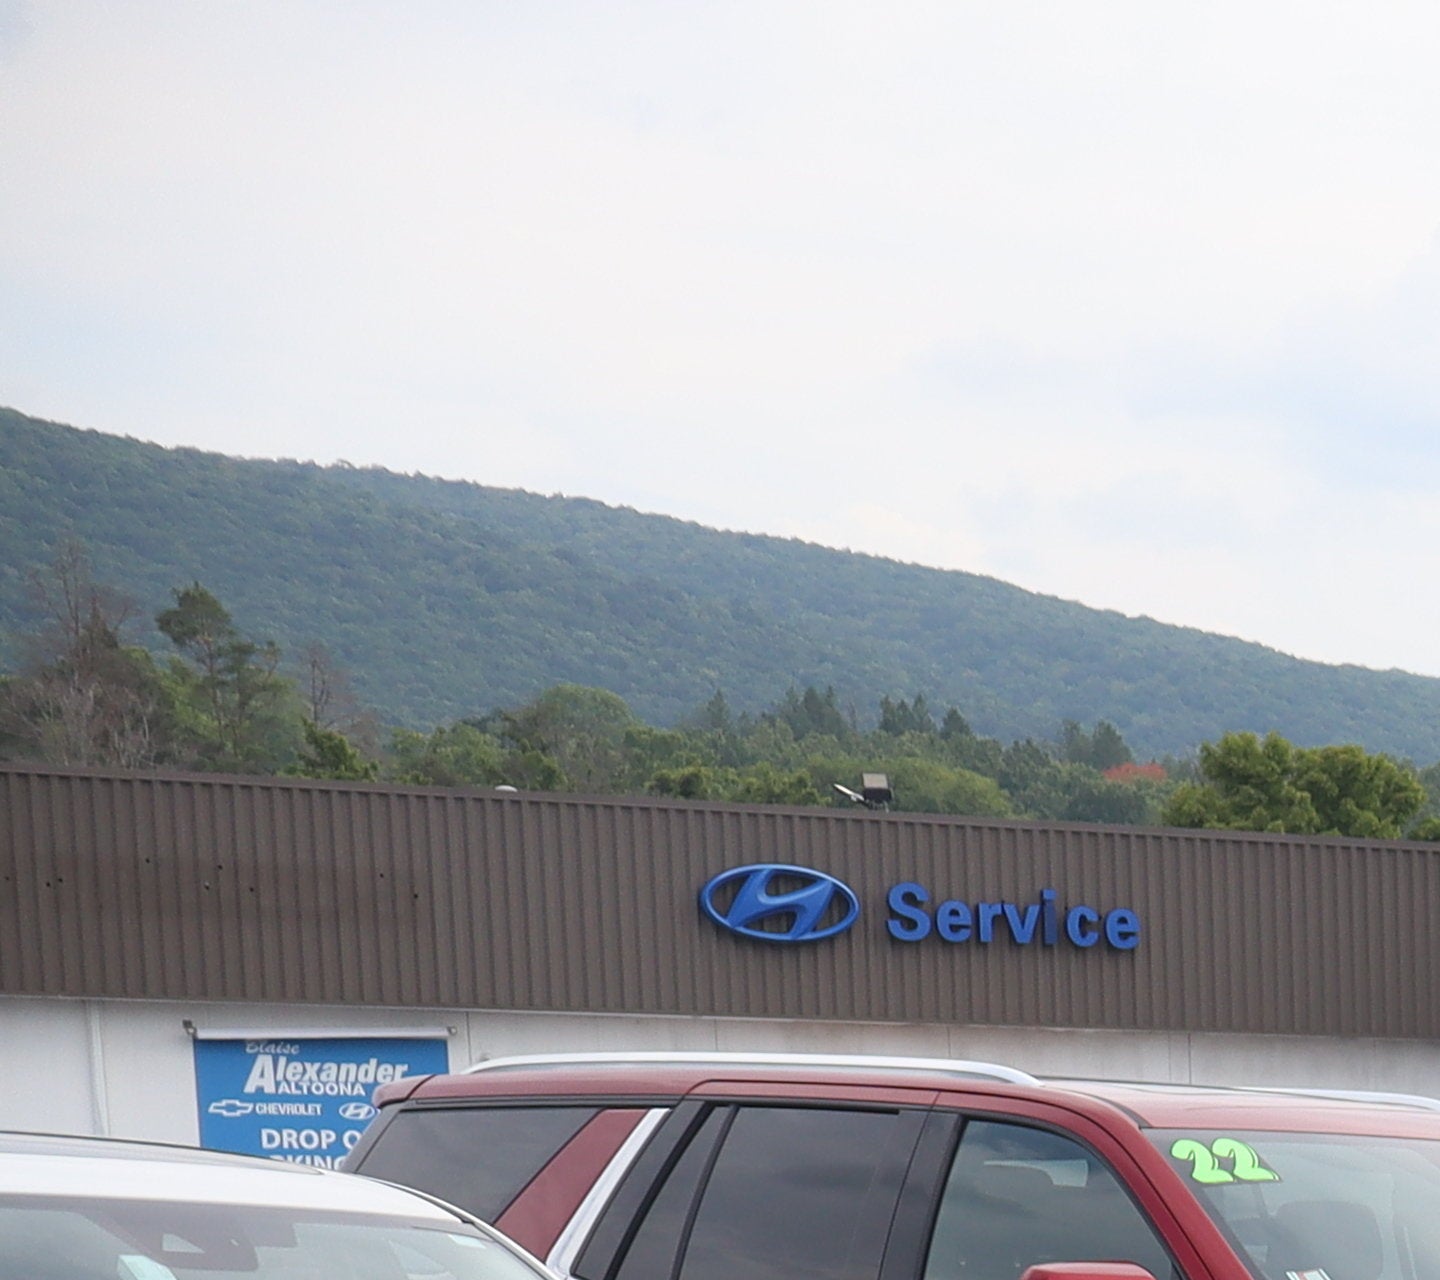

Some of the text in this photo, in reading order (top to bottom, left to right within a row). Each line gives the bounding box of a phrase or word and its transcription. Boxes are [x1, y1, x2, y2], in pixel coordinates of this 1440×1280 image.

[887, 881, 1141, 951] Service
[244, 1054, 408, 1094] Alexander
[277, 1081, 366, 1097] ALTOONA
[255, 1102, 322, 1116] CHEVROLET
[261, 1128, 336, 1149] DROP
[1170, 1137, 1281, 1184] 22
